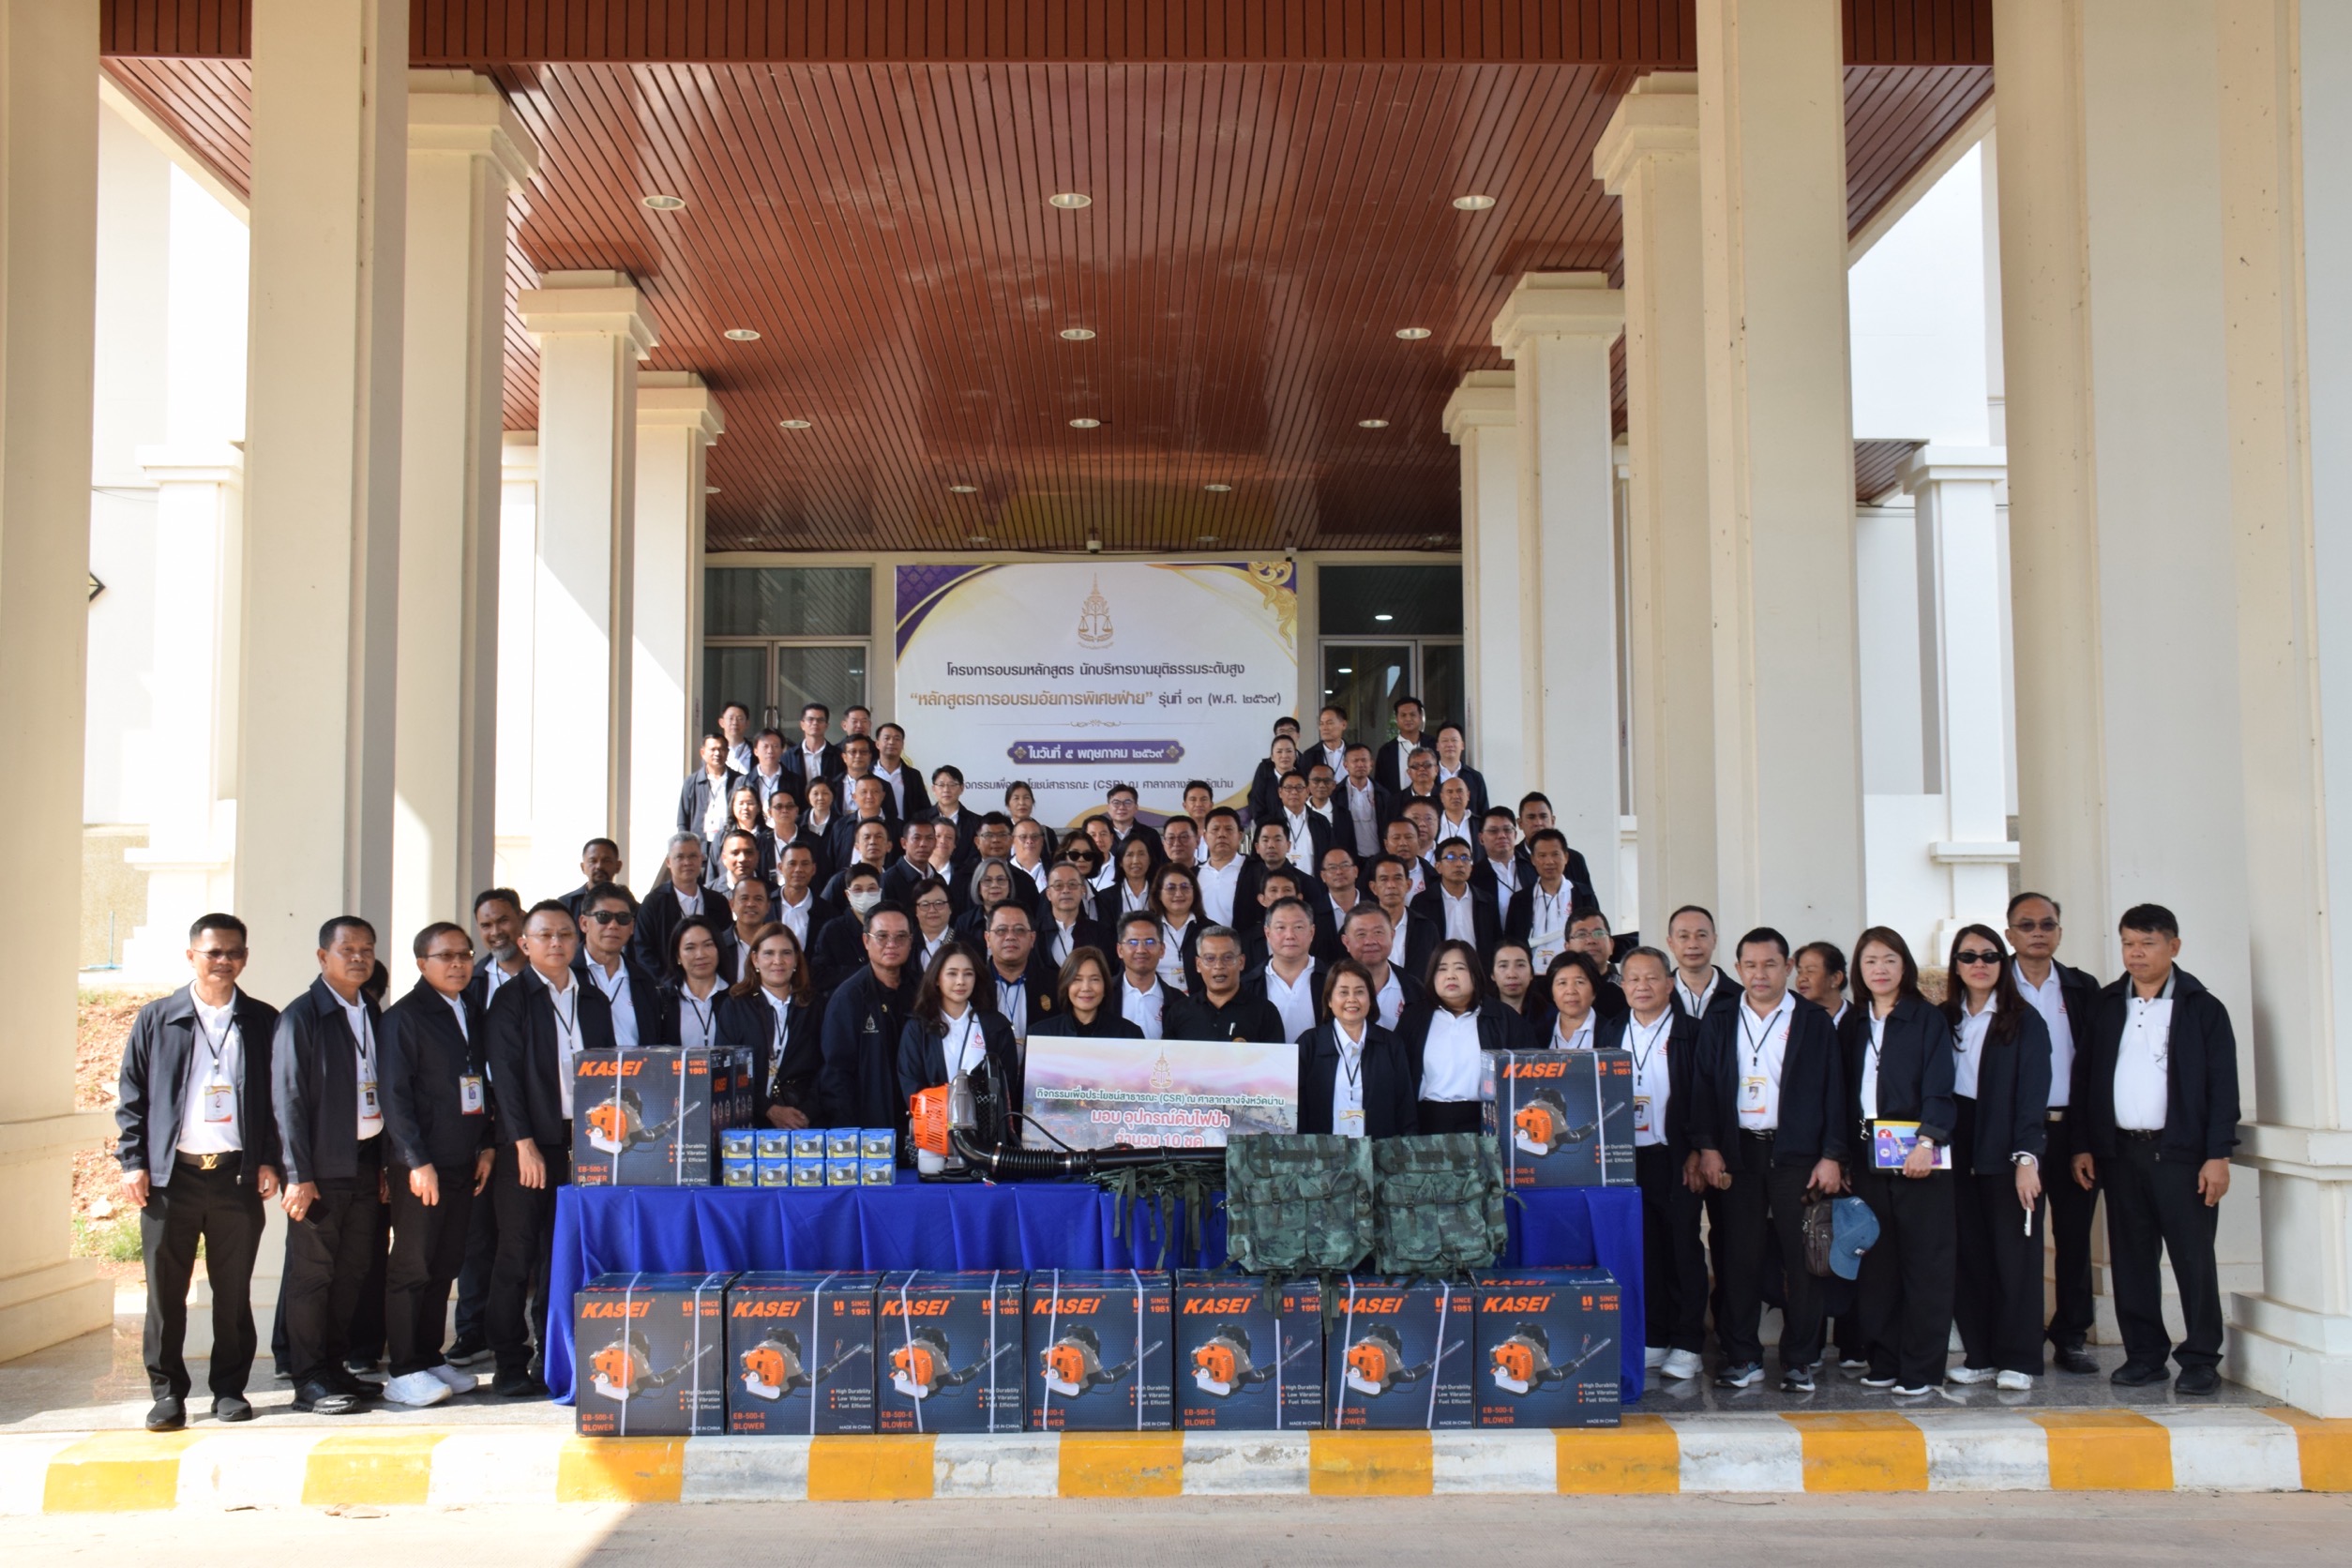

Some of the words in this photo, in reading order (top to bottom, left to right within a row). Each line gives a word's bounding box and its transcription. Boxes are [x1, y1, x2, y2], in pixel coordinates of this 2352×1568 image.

[947, 661, 1075, 679] โครงการอบรมหลักสูตร
[1079, 661, 1245, 678] นักบริหารงานยุติธรรมระดับสูง
[1158, 689, 1182, 708] รุ่นที่
[1208, 692, 1237, 706] (พ.ศ.
[1028, 745, 1061, 759] ในวันที่
[1078, 748, 1128, 761] พฤษภาคม
[577, 1060, 642, 1076] KASEI
[1502, 1062, 1567, 1078] KASEI
[1036, 1086, 1157, 1102] กิจกรรมเพื่อประโยชน์สาธารณะ
[1160, 1093, 1185, 1105] (CSR)
[1198, 1095, 1285, 1106] ศาลากลางจังหวัดน่าน
[1092, 1110, 1121, 1123] มอบ
[1124, 1108, 1229, 1129] อุปกรณ์ดับไฟป่า
[1116, 1129, 1159, 1146] จำนวน
[1165, 1134, 1181, 1146] 10
[580, 1302, 650, 1319] KASEI
[731, 1301, 802, 1318] KASEI
[881, 1300, 950, 1316] KASEI
[1033, 1298, 1101, 1315] KASEI
[1183, 1297, 1252, 1315] KASEI
[1482, 1296, 1551, 1313] KASEI
